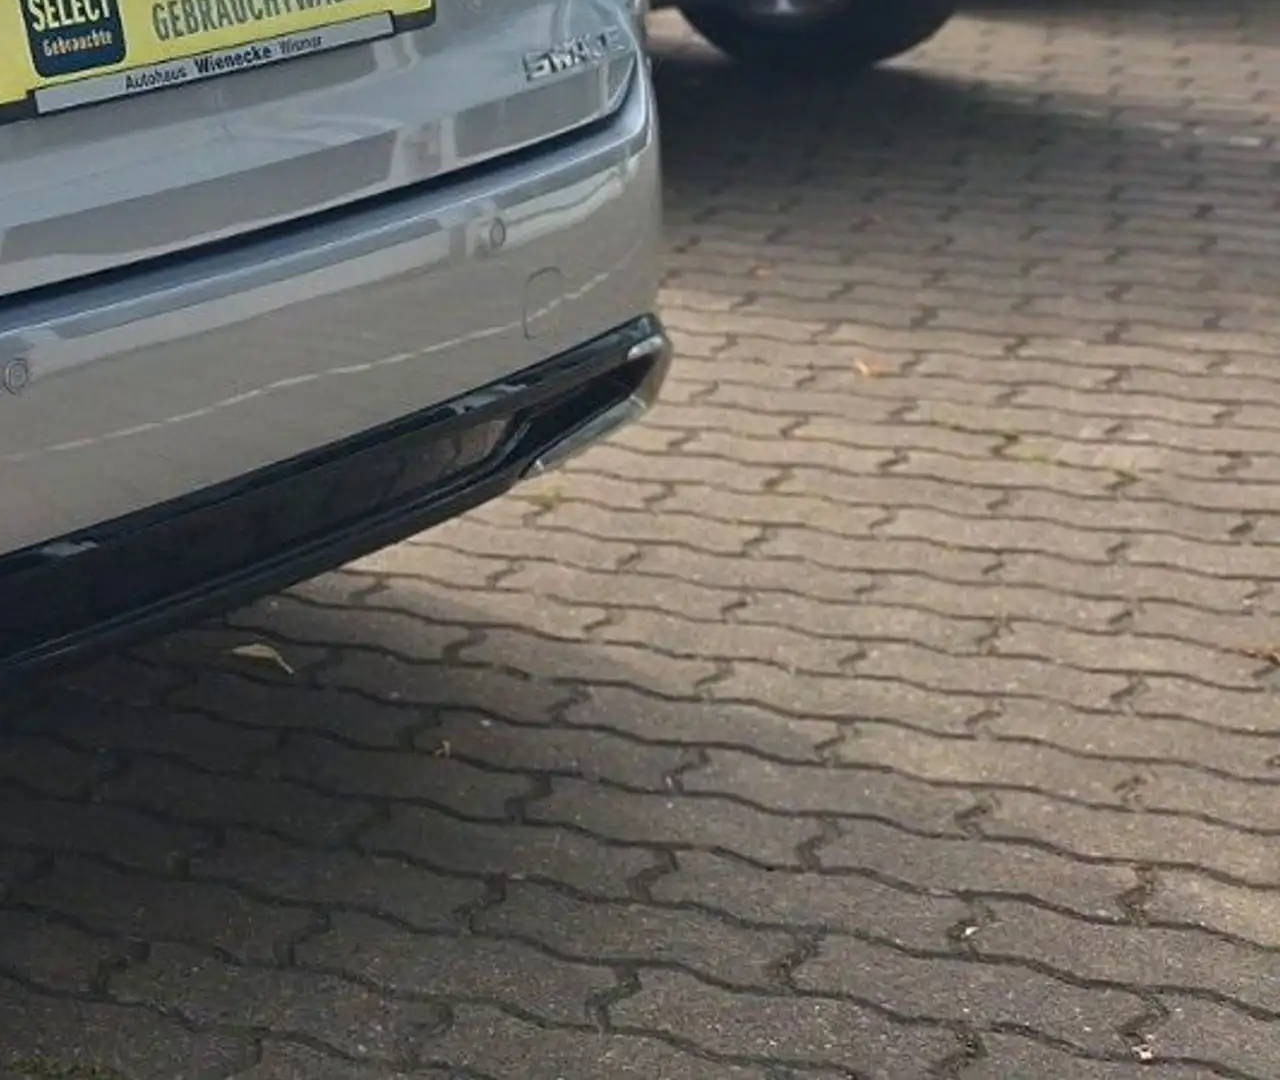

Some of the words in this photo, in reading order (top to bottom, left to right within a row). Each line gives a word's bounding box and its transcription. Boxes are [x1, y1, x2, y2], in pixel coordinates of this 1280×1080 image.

[42, 29, 113, 57] Gebrauchte
[124, 66, 187, 91] Autohaus
[192, 45, 273, 74] Wienecke
